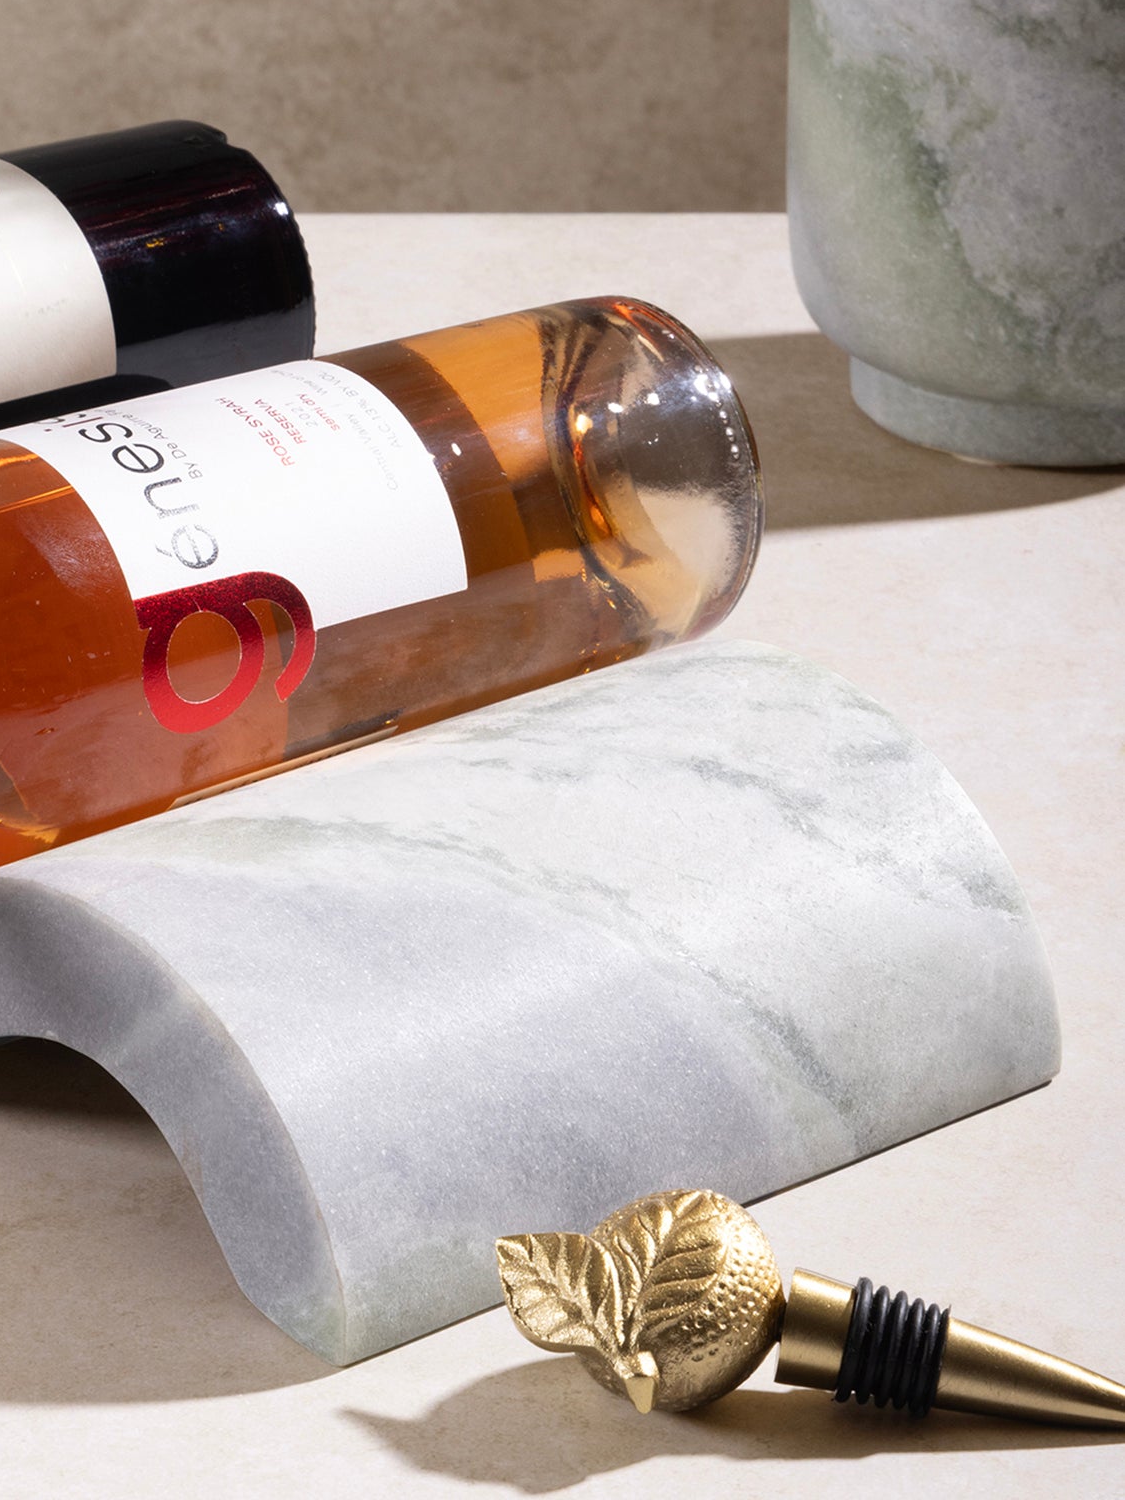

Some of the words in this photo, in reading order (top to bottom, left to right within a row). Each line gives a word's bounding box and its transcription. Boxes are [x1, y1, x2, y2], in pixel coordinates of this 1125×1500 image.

[215, 397, 263, 428] SYRAH
[254, 398, 307, 445] RESERVA
[284, 401, 319, 428] 2021
[313, 406, 341, 431] semi
[166, 442, 187, 459] De
[258, 429, 295, 466] ROSE
[183, 461, 204, 479] By
